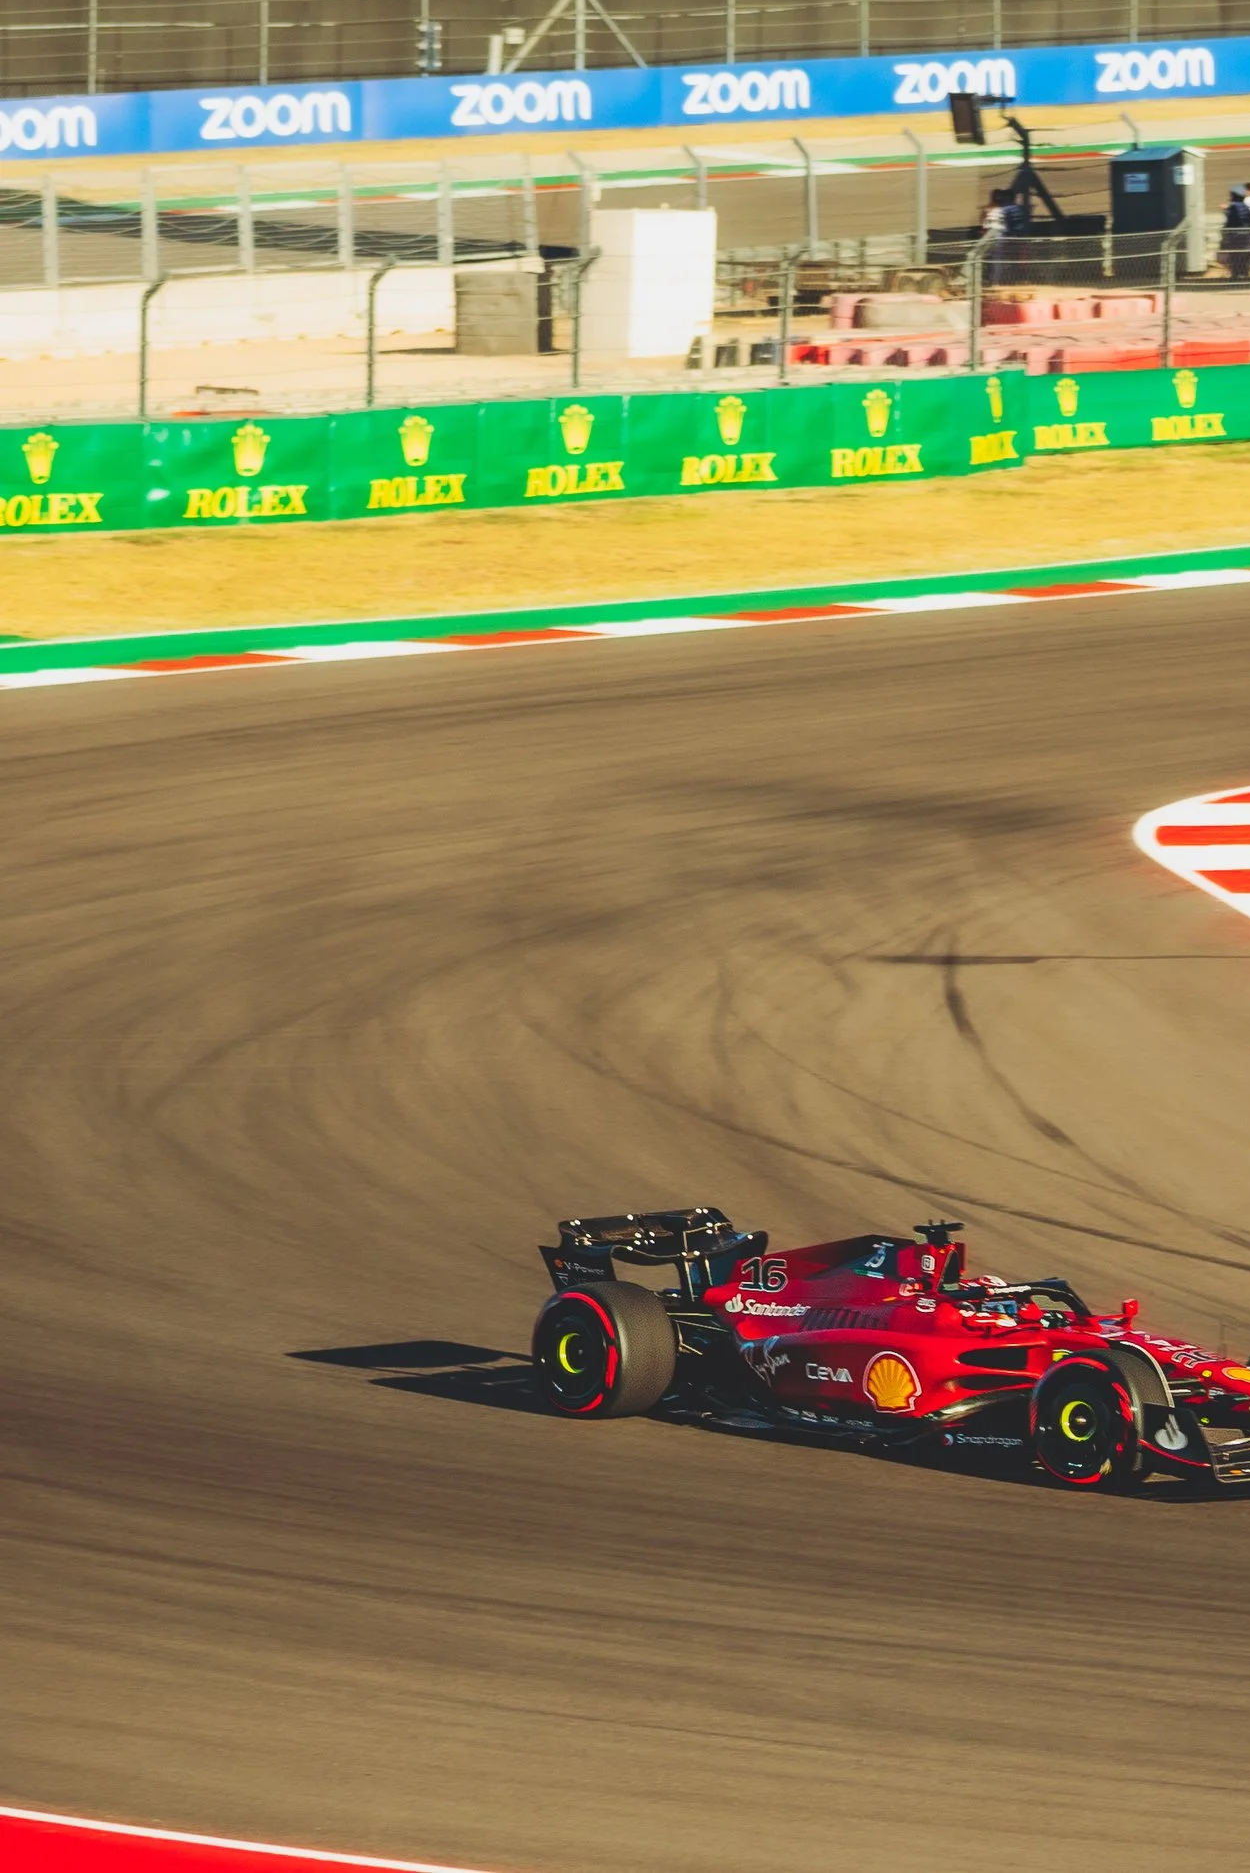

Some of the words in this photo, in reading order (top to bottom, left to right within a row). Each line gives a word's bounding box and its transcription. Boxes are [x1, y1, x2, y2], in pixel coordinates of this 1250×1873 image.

[893, 57, 1016, 105] zoom
[1095, 46, 1215, 93] zoom
[450, 79, 592, 127] zoom
[681, 67, 810, 116] zoom
[199, 91, 352, 143] zoom
[1151, 412, 1227, 442] ROLEX
[524, 460, 625, 498] ROLEX
[680, 452, 779, 487] ROLEX
[830, 443, 924, 479] ROLEX
[183, 484, 309, 519] ROLEX
[366, 473, 467, 509] ROLEX
[738, 1257, 788, 1293] 16
